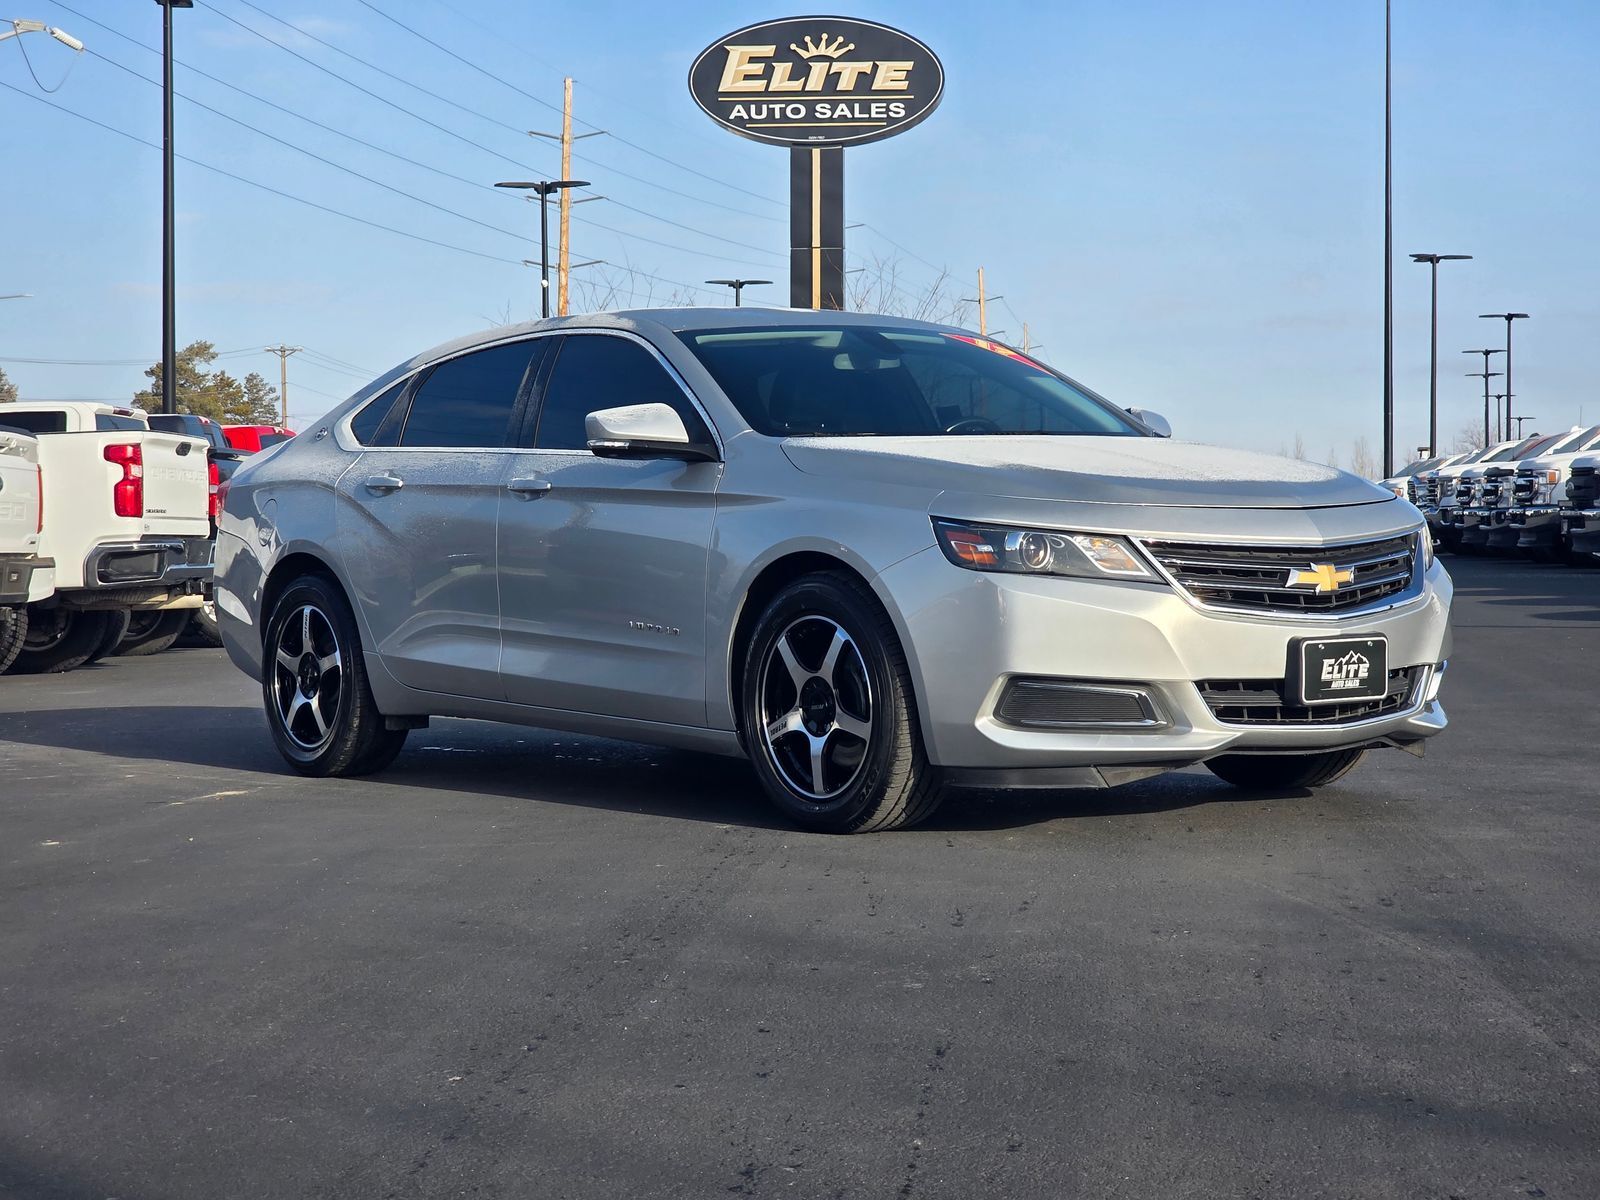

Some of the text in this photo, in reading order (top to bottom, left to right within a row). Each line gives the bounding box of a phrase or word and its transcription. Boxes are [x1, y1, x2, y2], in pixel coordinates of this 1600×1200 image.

[718, 45, 914, 92] ELITE
[729, 102, 906, 120] AUTO SALES
[1321, 658, 1370, 680] ELITE
[1330, 679, 1360, 688] AUTO SALES
